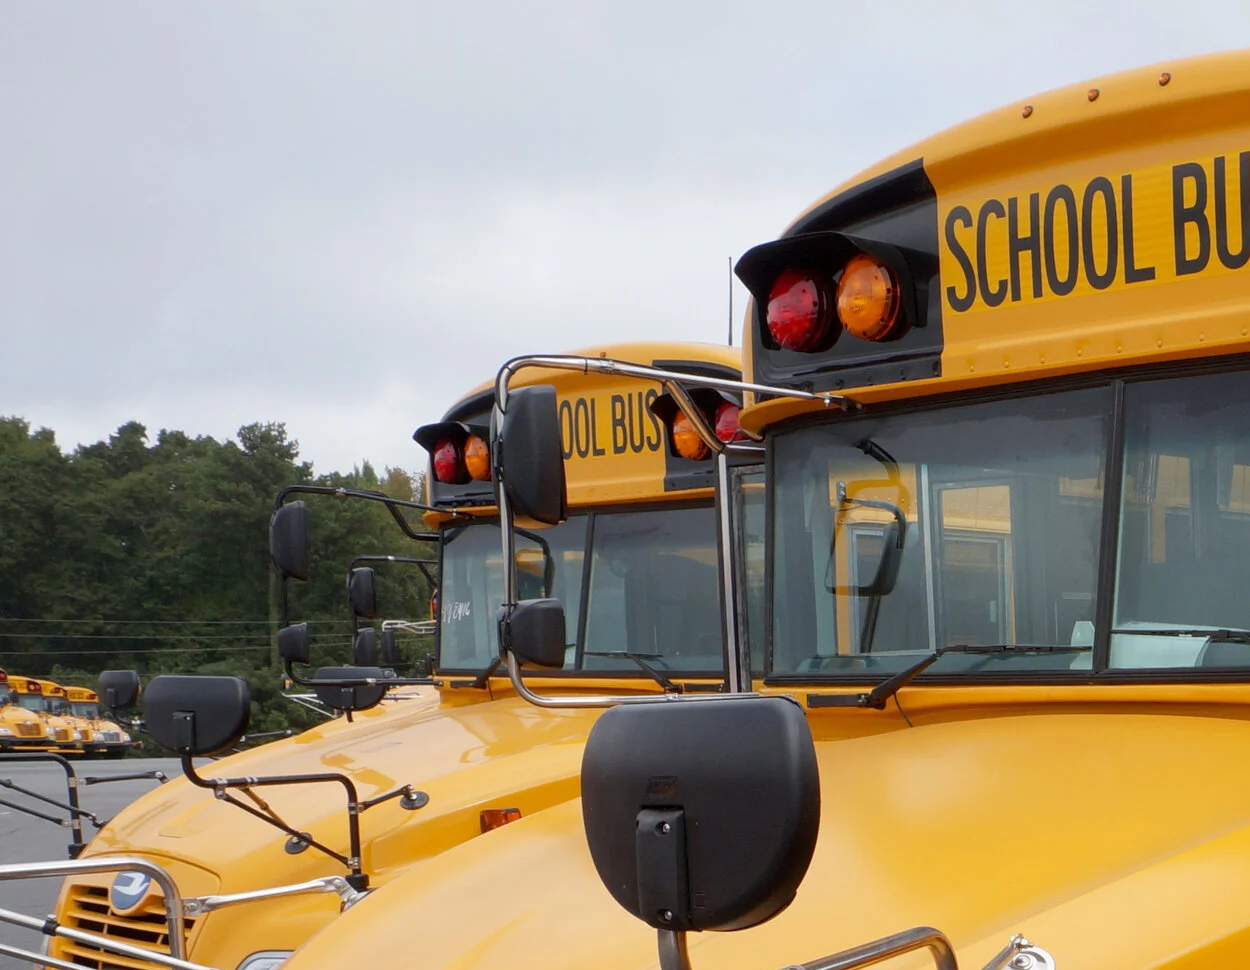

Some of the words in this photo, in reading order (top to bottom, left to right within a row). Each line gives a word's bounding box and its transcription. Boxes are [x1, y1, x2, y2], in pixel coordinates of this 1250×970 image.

[944, 173, 1156, 312] SCHOOL
[559, 398, 605, 460] OOL
[612, 388, 661, 454] BUS
